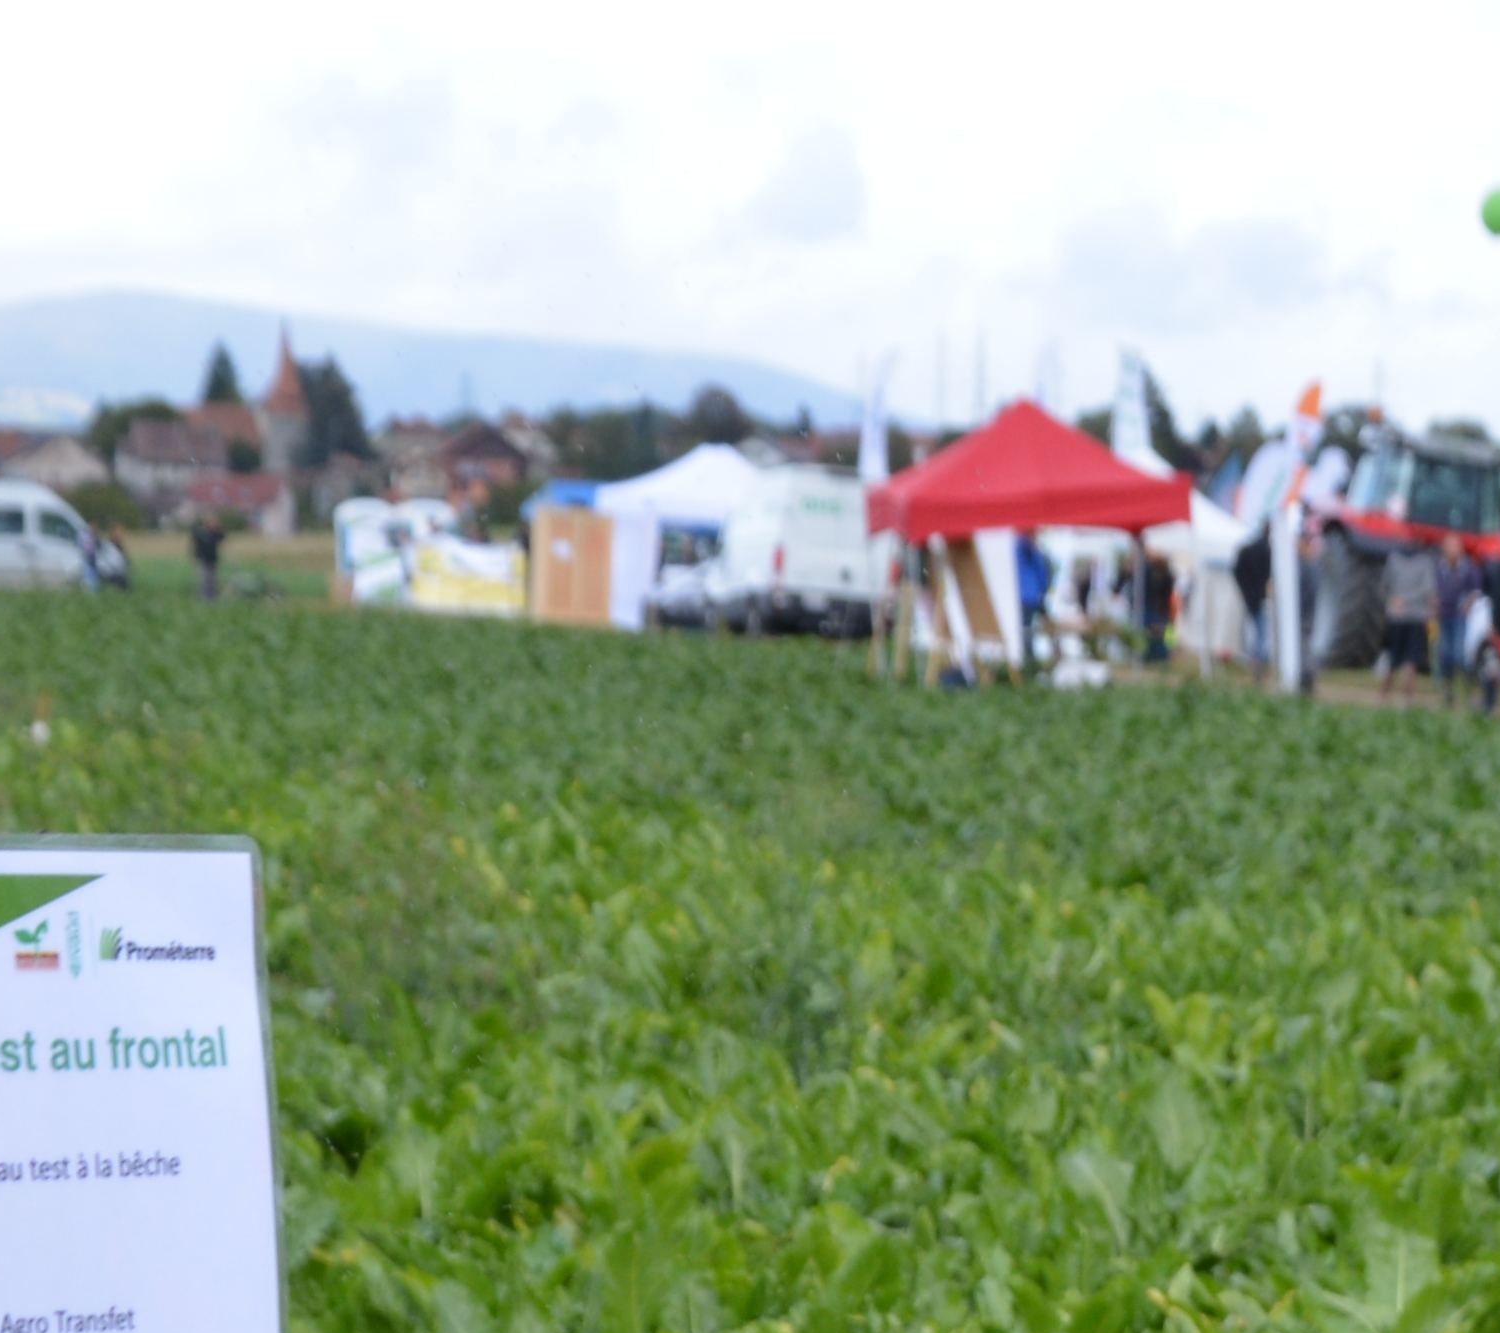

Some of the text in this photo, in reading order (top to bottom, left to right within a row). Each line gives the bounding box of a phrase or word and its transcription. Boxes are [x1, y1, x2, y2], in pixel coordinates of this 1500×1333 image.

[127, 941, 215, 960] Prométerre
[51, 1039, 96, 1070] au
[108, 1026, 227, 1069] frontal
[30, 1158, 70, 1181] test
[77, 1154, 88, 1179] à
[95, 1153, 112, 1178] la
[119, 1151, 180, 1177] bêche
[55, 1307, 135, 1333] Transfet
